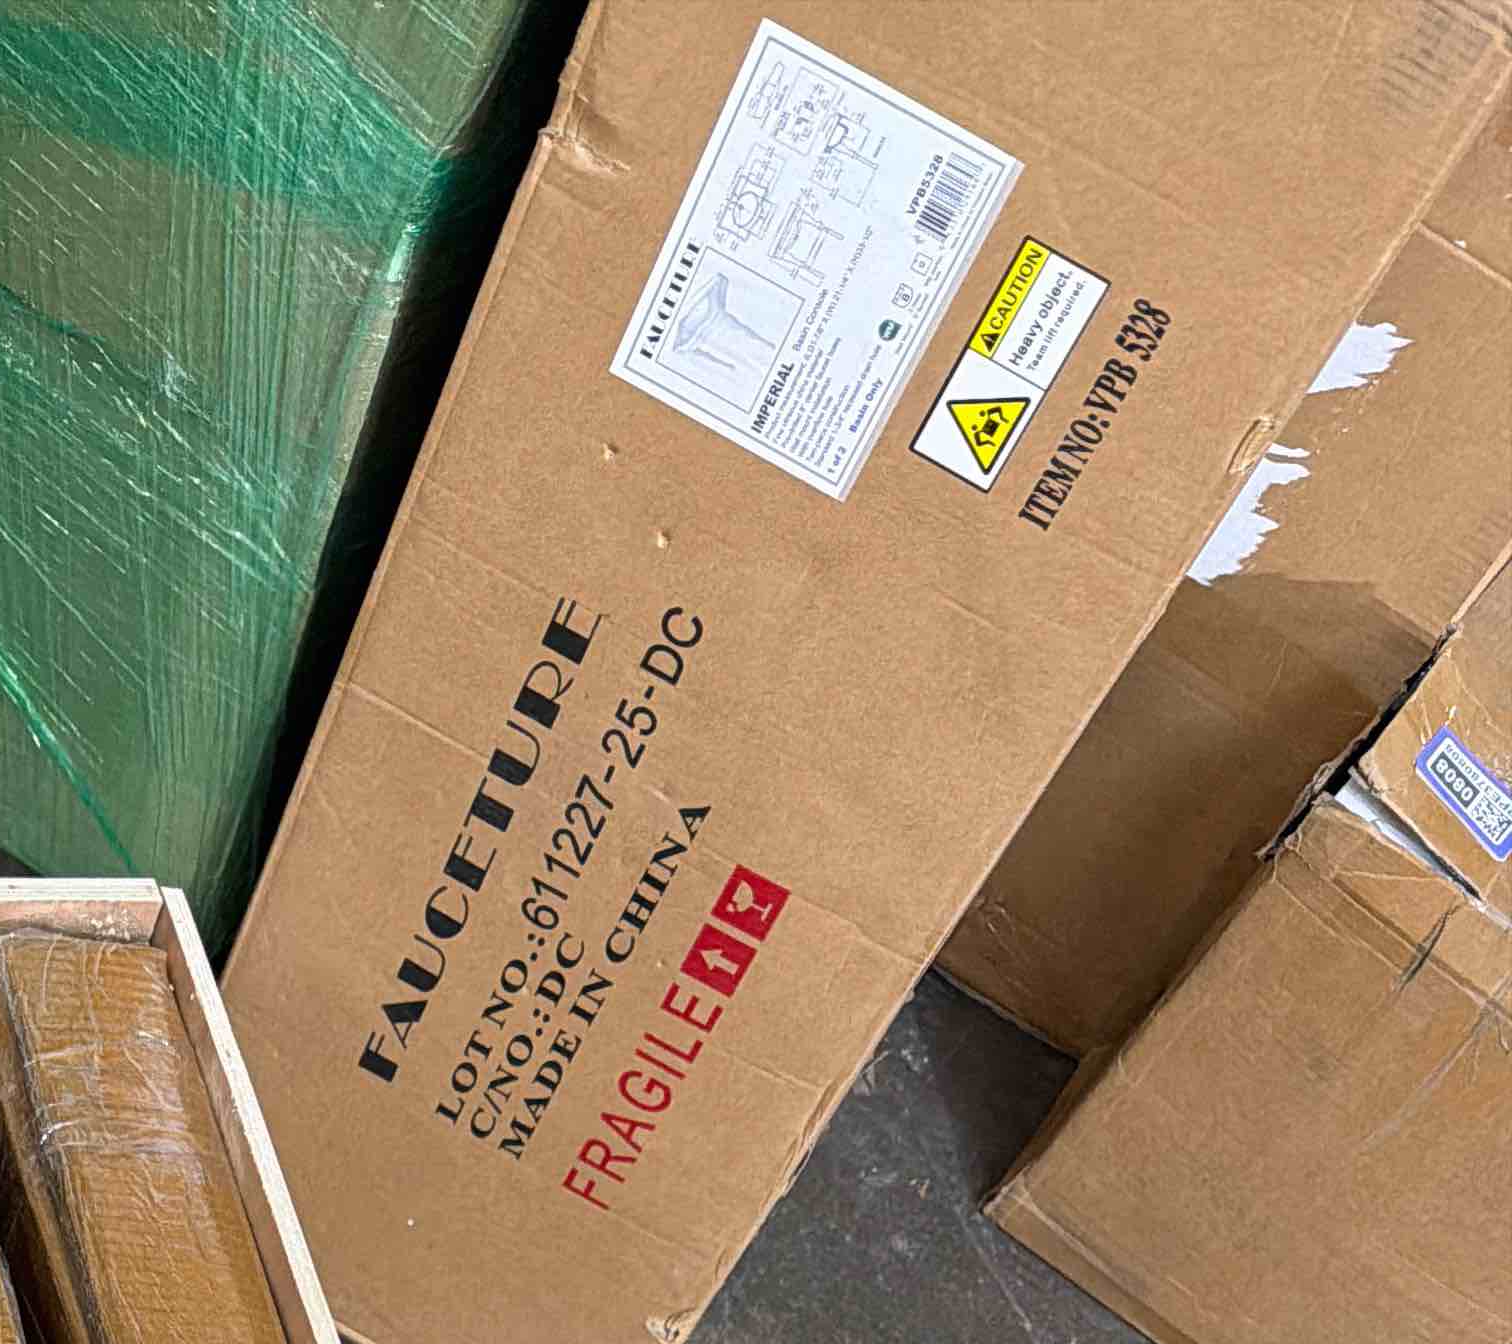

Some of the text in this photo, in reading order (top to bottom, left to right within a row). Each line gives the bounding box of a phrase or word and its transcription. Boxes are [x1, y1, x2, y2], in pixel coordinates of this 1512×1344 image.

[906, 155, 943, 214] VPB5328
[990, 248, 1043, 330] CAUTION
[1008, 271, 1072, 366] Heavy object.
[1026, 282, 1084, 370] Team lift required.
[751, 363, 794, 434] IMPERIAL
[848, 378, 883, 433] Basin Only
[1018, 456, 1082, 531] ITEM
[1115, 299, 1171, 362] 5328
[1435, 758, 1474, 801] 0808
[358, 597, 603, 1083] FAUCETURE
[498, 806, 711, 1160] MADE IN CHINA
[435, 1030, 493, 1124] LOT
[562, 983, 723, 1210] FRAGILE
